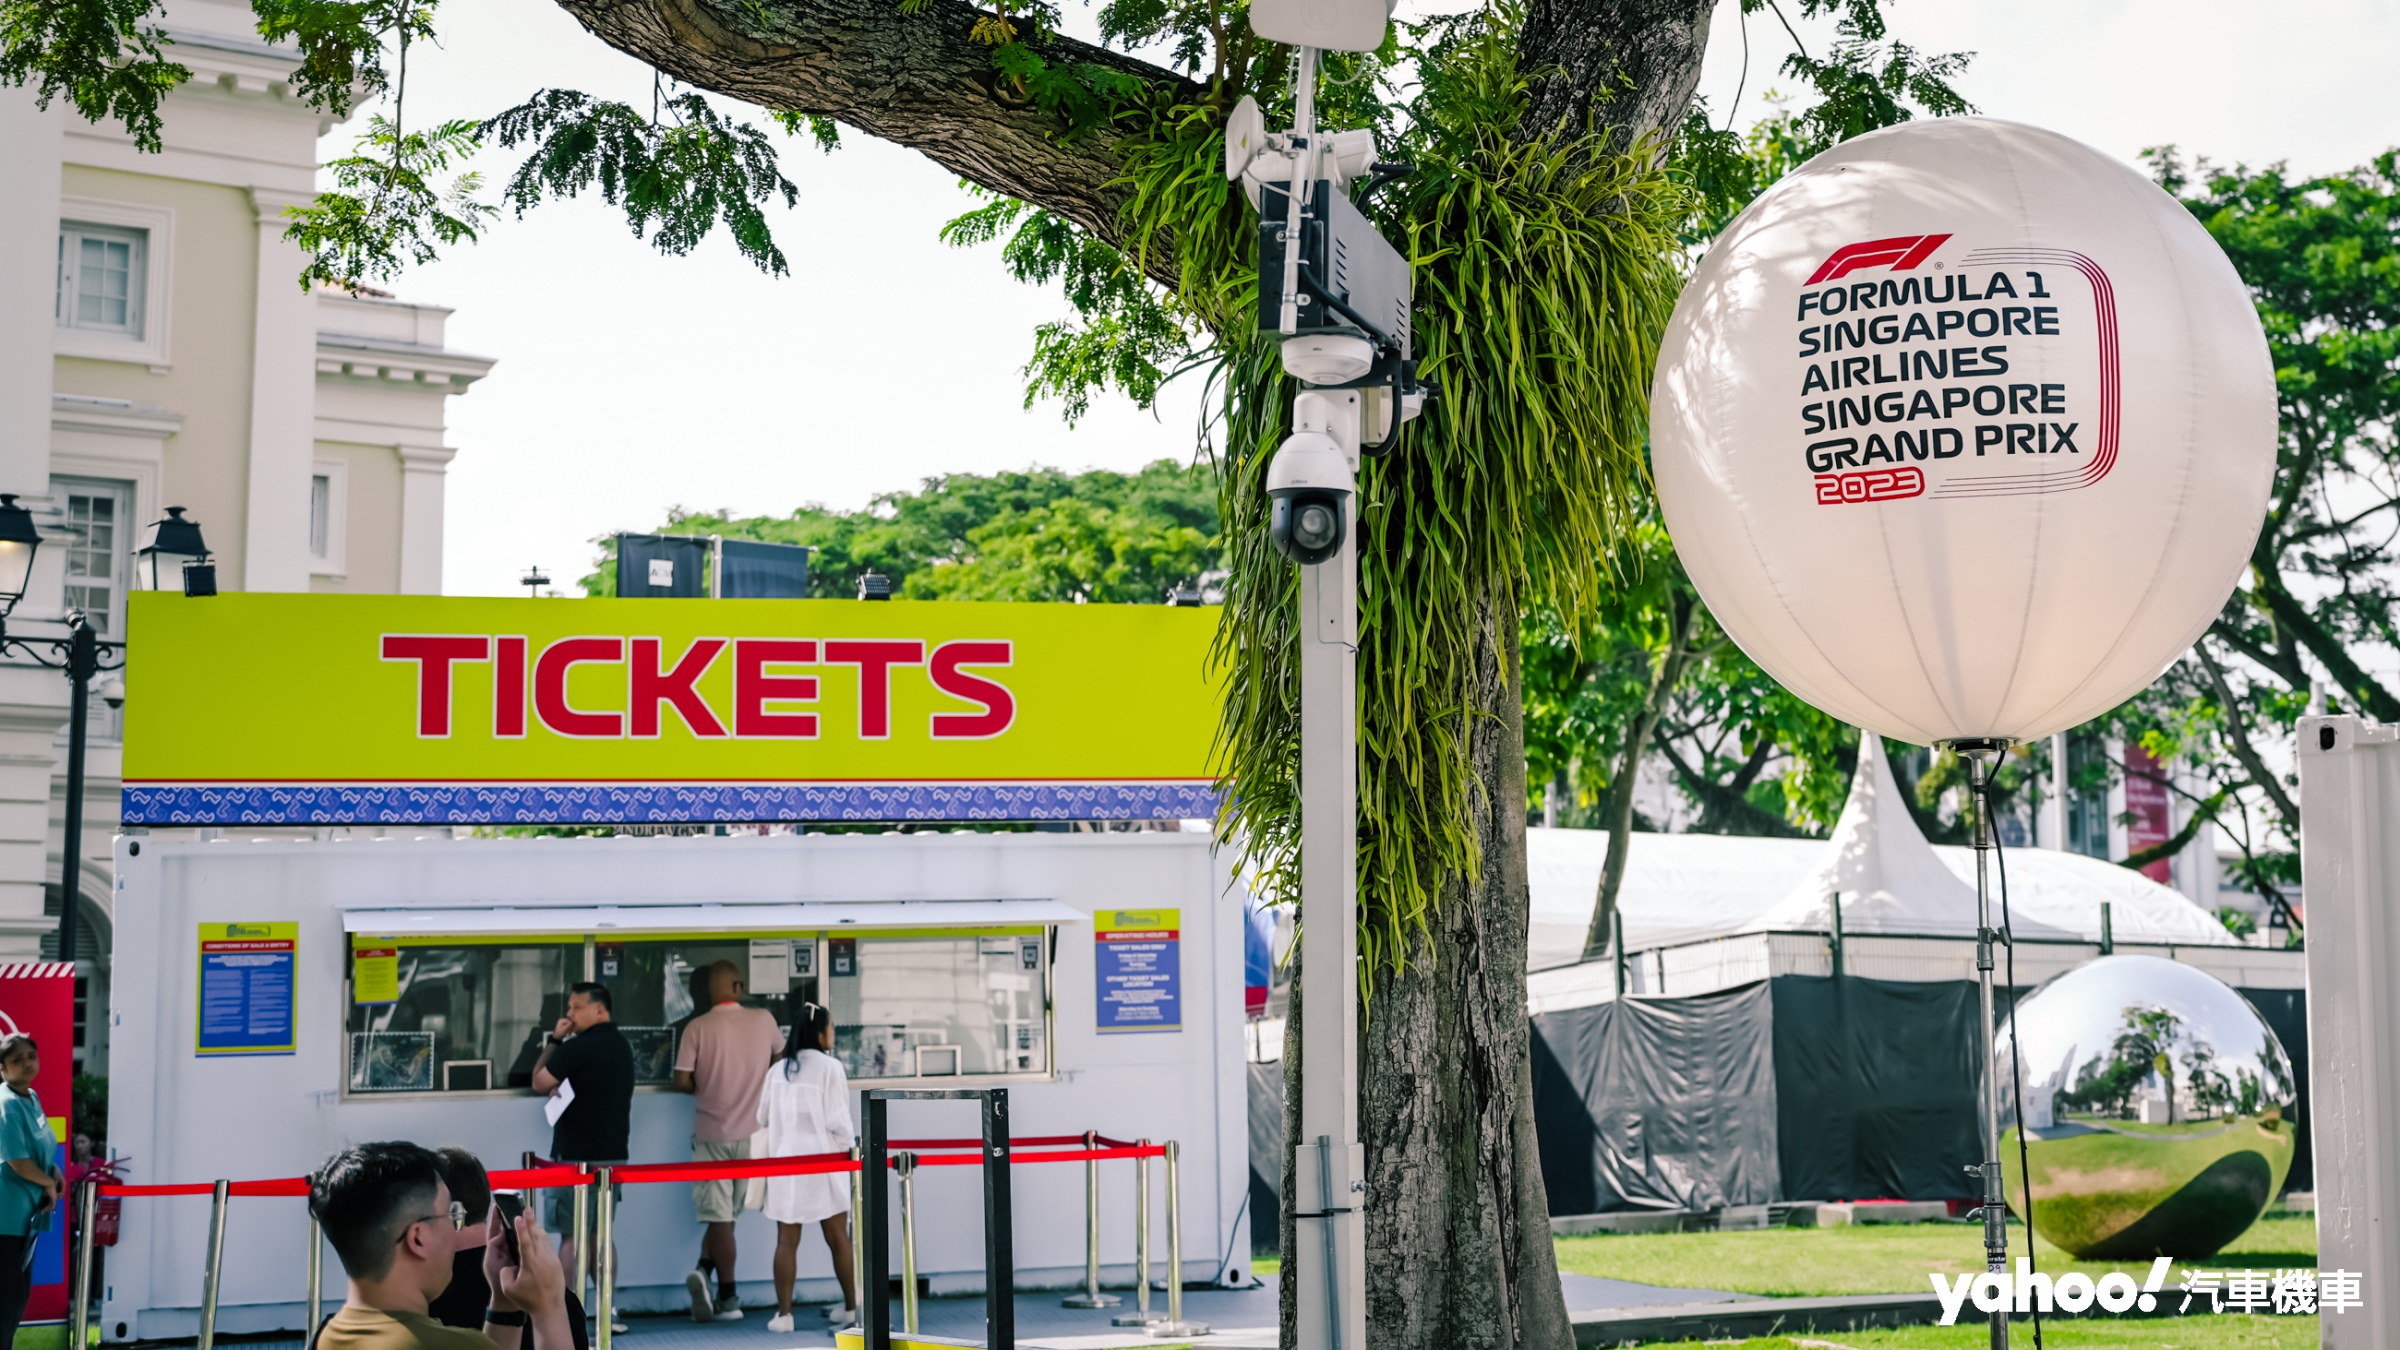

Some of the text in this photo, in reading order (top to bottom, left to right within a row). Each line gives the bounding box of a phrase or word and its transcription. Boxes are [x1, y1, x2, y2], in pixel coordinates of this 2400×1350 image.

[1797, 271, 2051, 322] FORMULA 1
[1798, 306, 2060, 358] SINGAPORE
[1800, 345, 2009, 397] AIRLINES
[1801, 383, 2066, 435] SINGAPORE
[1805, 422, 2080, 473] GRAND PRIX
[1815, 467, 1924, 504] 2023
[379, 631, 1017, 741] TICKETS
